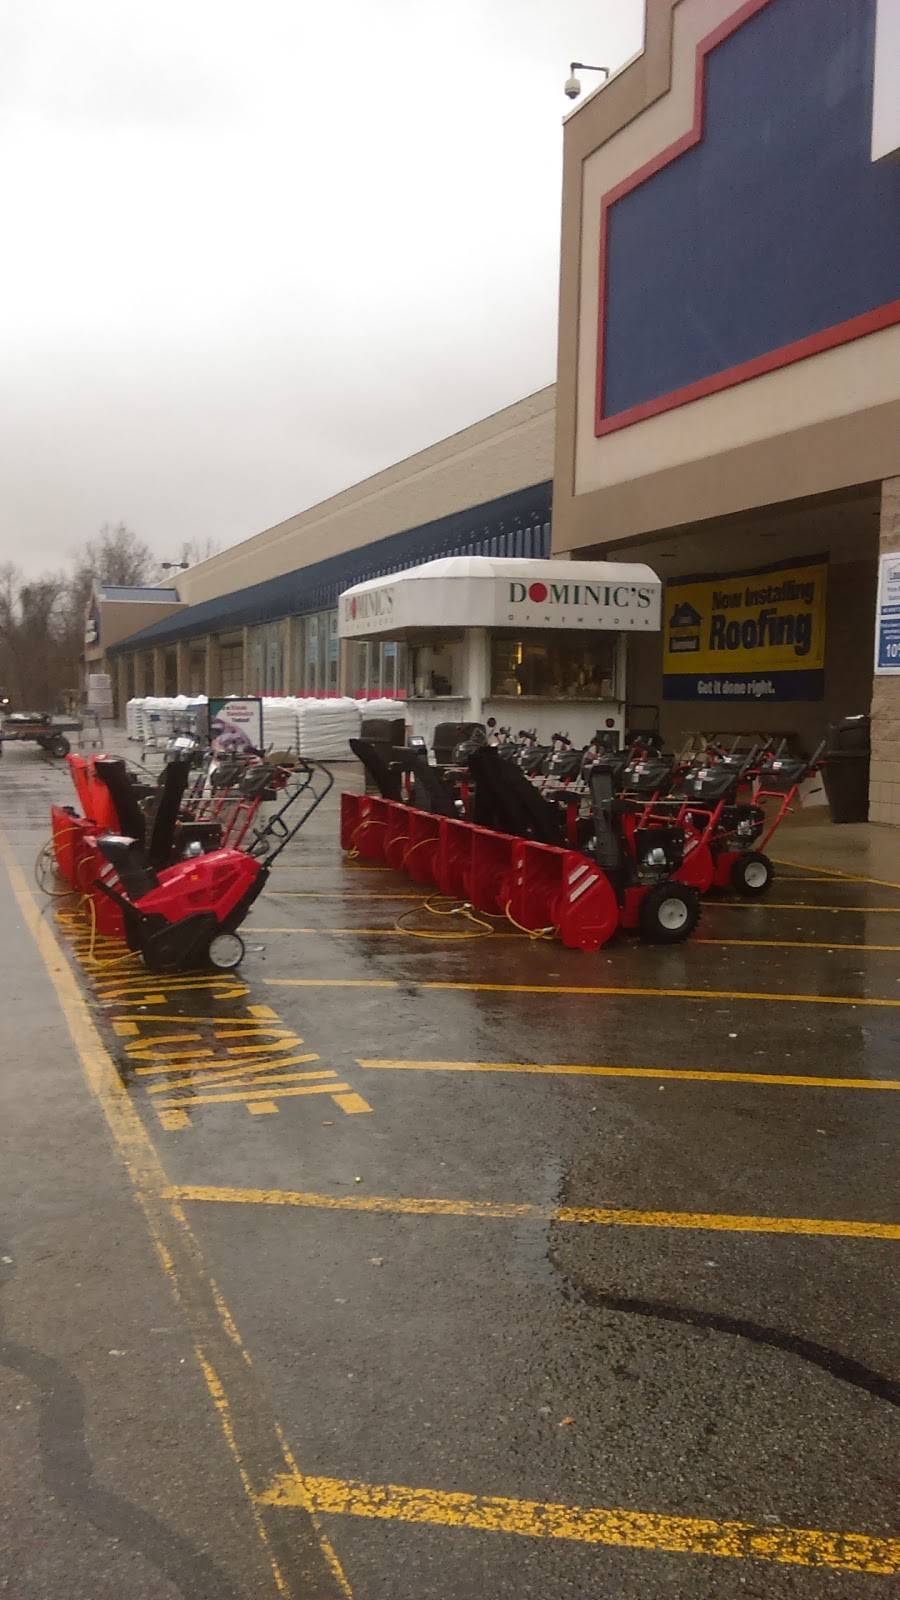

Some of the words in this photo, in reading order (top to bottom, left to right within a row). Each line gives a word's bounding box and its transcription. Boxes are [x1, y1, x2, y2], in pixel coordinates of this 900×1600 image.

[509, 582, 651, 608] DOMINIC'S
[712, 591, 741, 610] Now
[745, 579, 815, 605] Installing
[710, 608, 812, 656] Roofing
[697, 680, 712, 694] Get
[714, 680, 721, 694] it
[722, 680, 746, 694] done
[747, 679, 776, 697] right.
